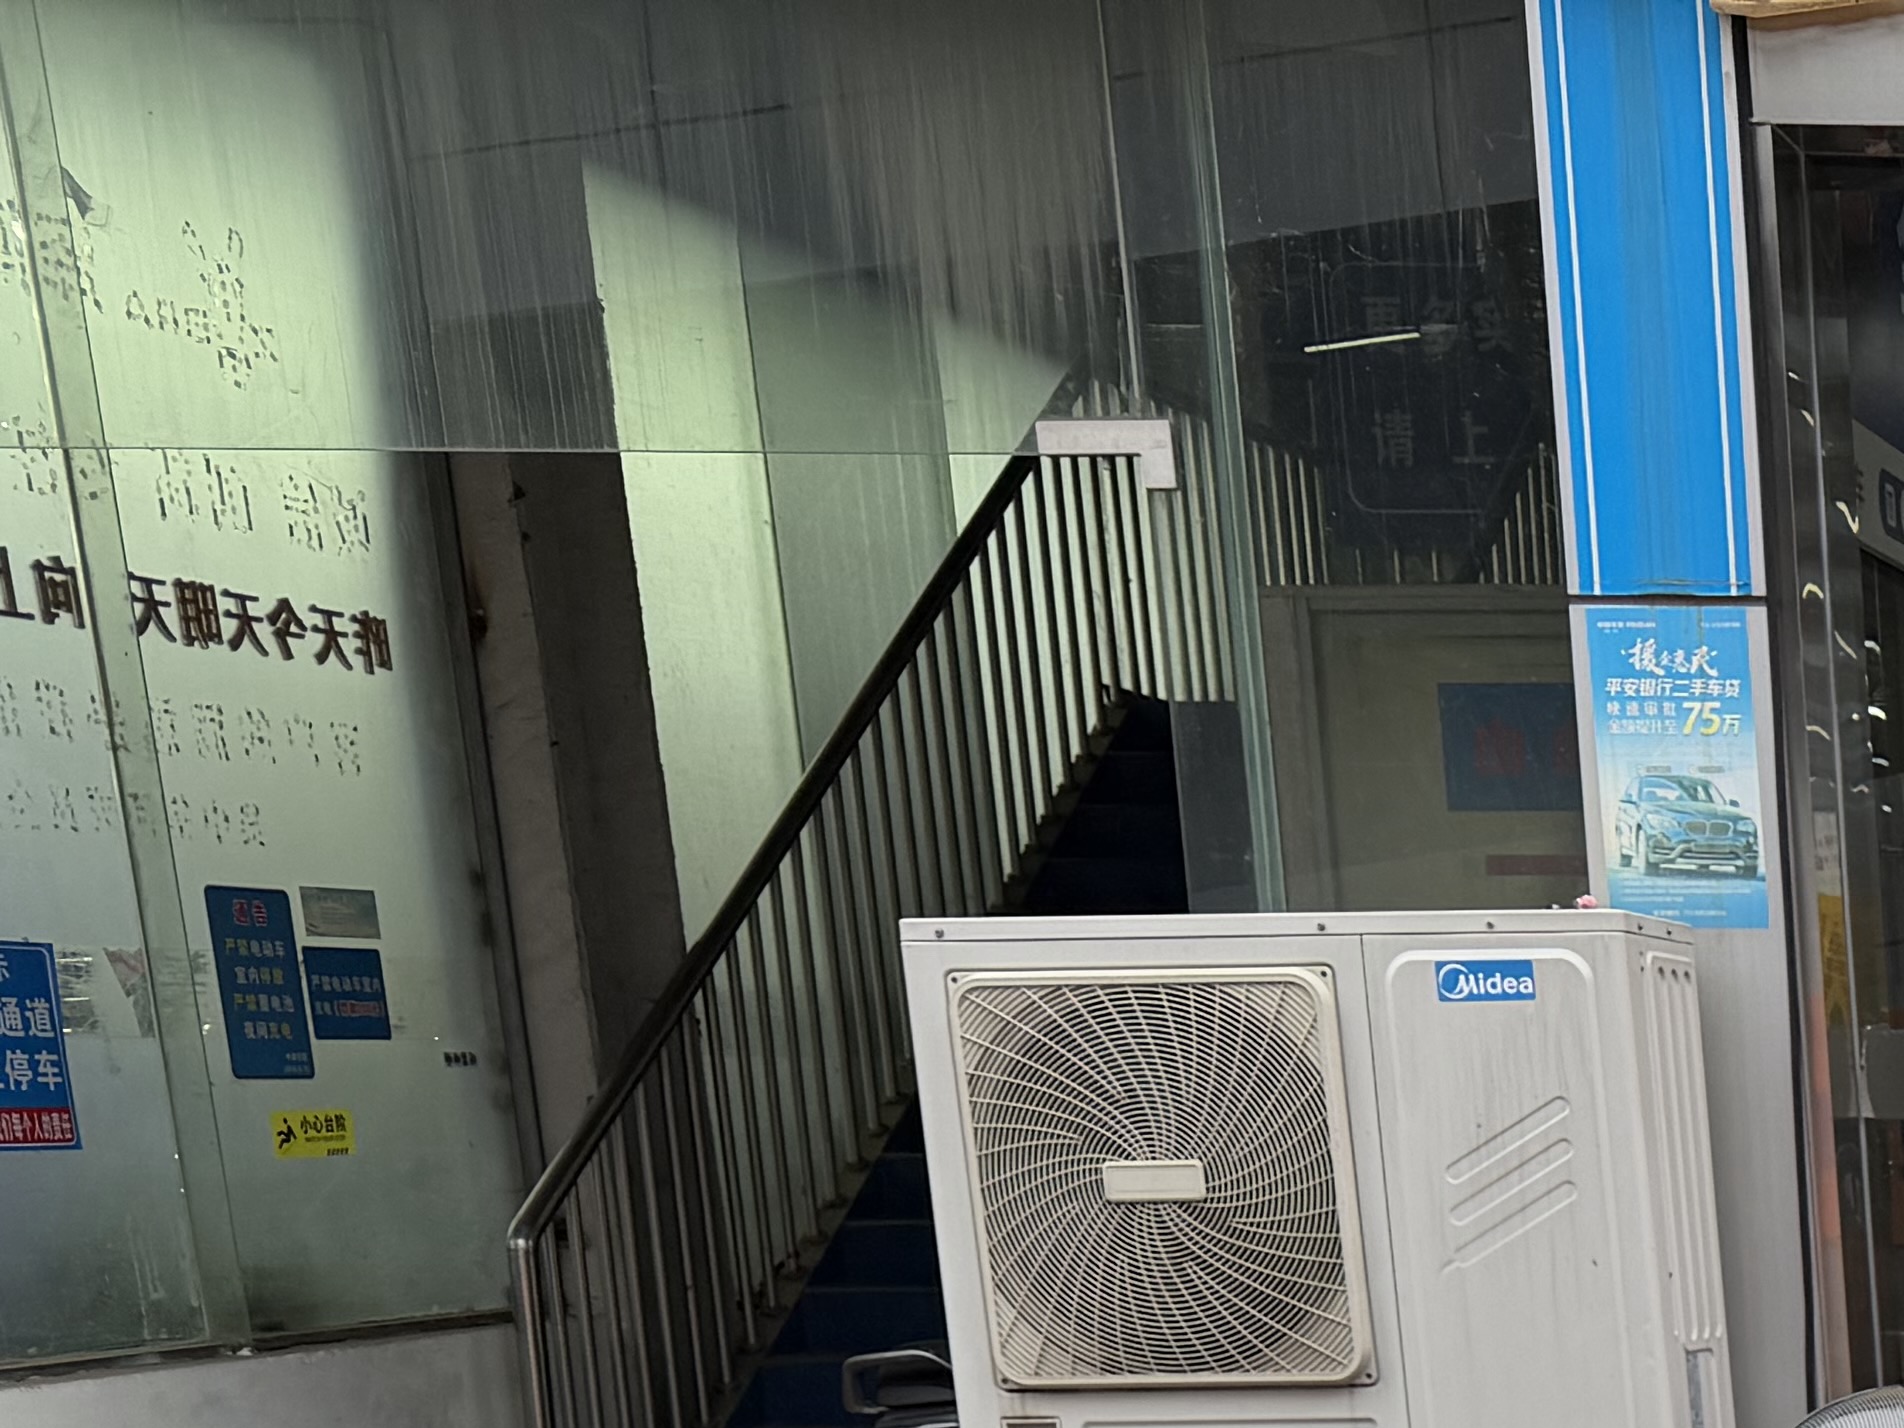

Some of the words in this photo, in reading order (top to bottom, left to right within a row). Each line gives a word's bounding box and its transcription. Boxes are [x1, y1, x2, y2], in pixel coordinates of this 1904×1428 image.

[1605, 677, 1742, 698] 平安银行二手车贷
[1682, 700, 1743, 737] 75万
[1440, 965, 1534, 998] Midea
[0, 996, 55, 1038] 通道
[0, 1049, 63, 1092] 停车
[0, 1110, 73, 1142] 们每个人的责任
[300, 1113, 347, 1134] 小心台阶
